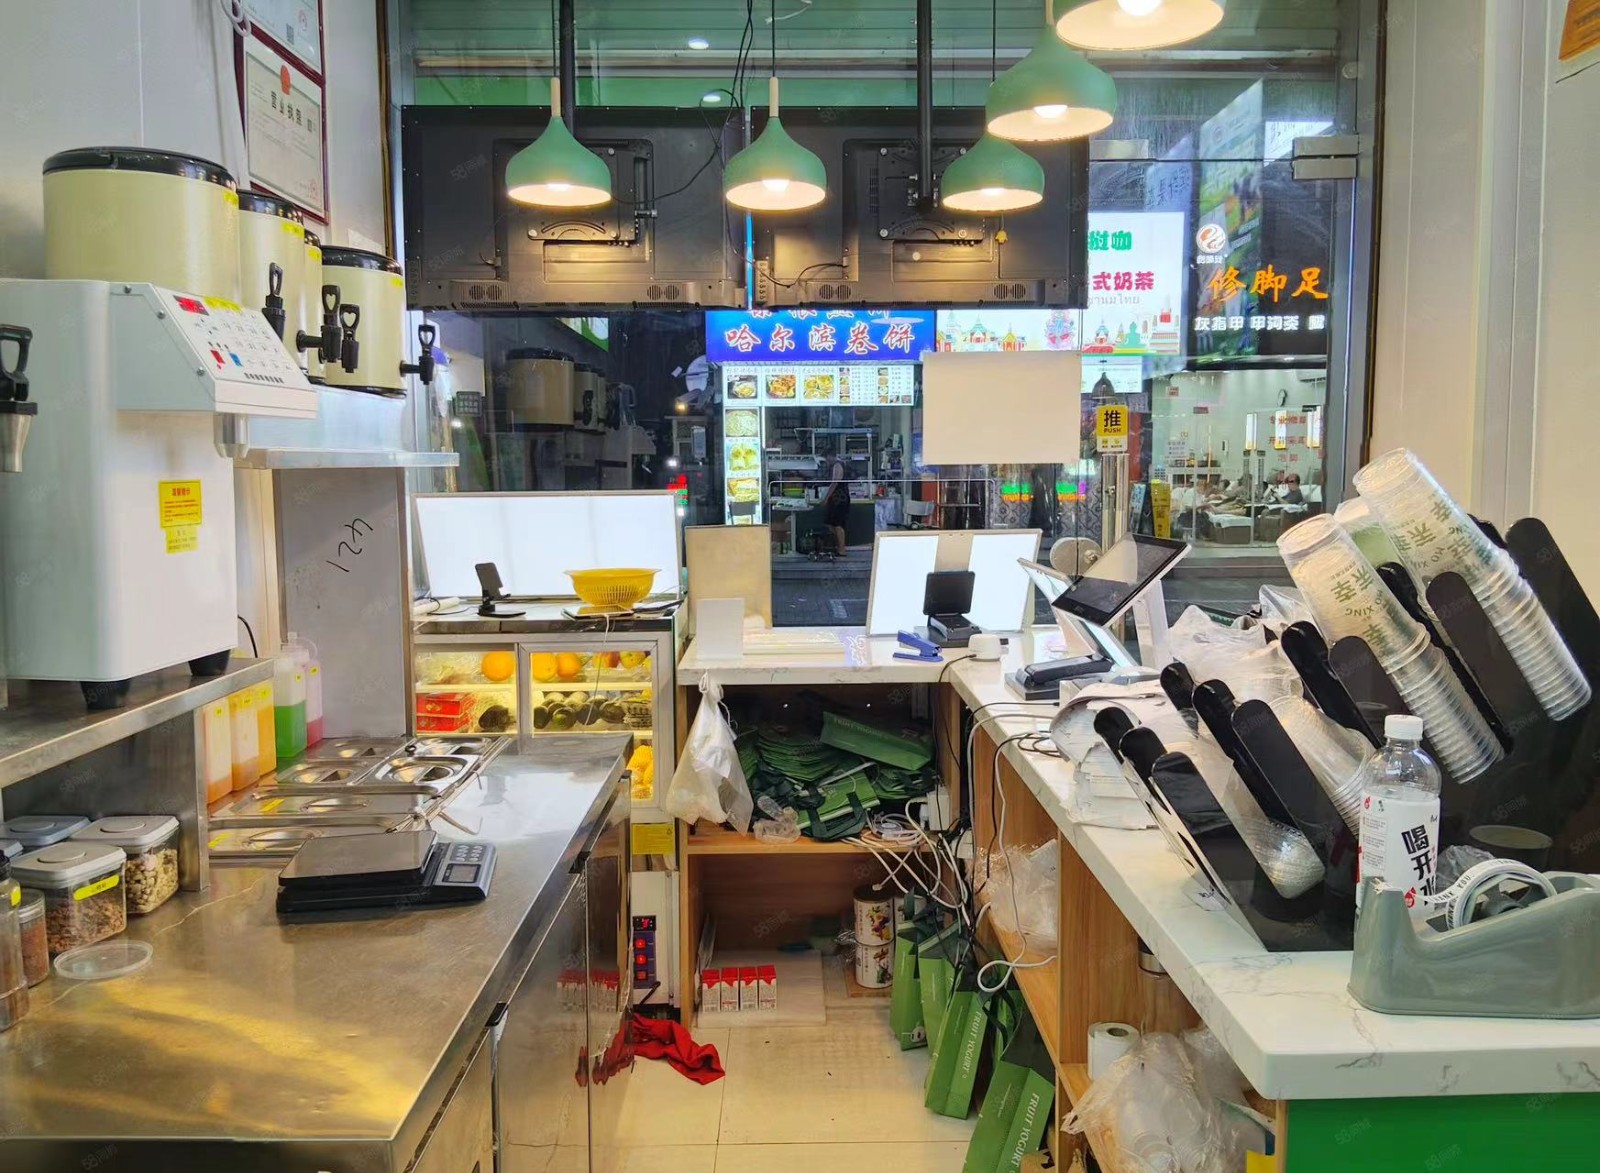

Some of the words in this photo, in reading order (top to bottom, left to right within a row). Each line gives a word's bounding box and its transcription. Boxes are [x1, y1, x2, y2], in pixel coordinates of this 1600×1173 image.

[1092, 271, 1154, 291] 式奶茶
[725, 321, 915, 354] 哈尔滨卷饼
[1194, 315, 1244, 331] 灰指甲
[1103, 409, 1122, 427] 推
[1344, 606, 1375, 617] XING
[971, 1010, 982, 1040] FRUIT
[963, 1039, 976, 1074] YOGURT
[1025, 1092, 1040, 1125] FRUIT
[1010, 1124, 1032, 1167] YOGURT
